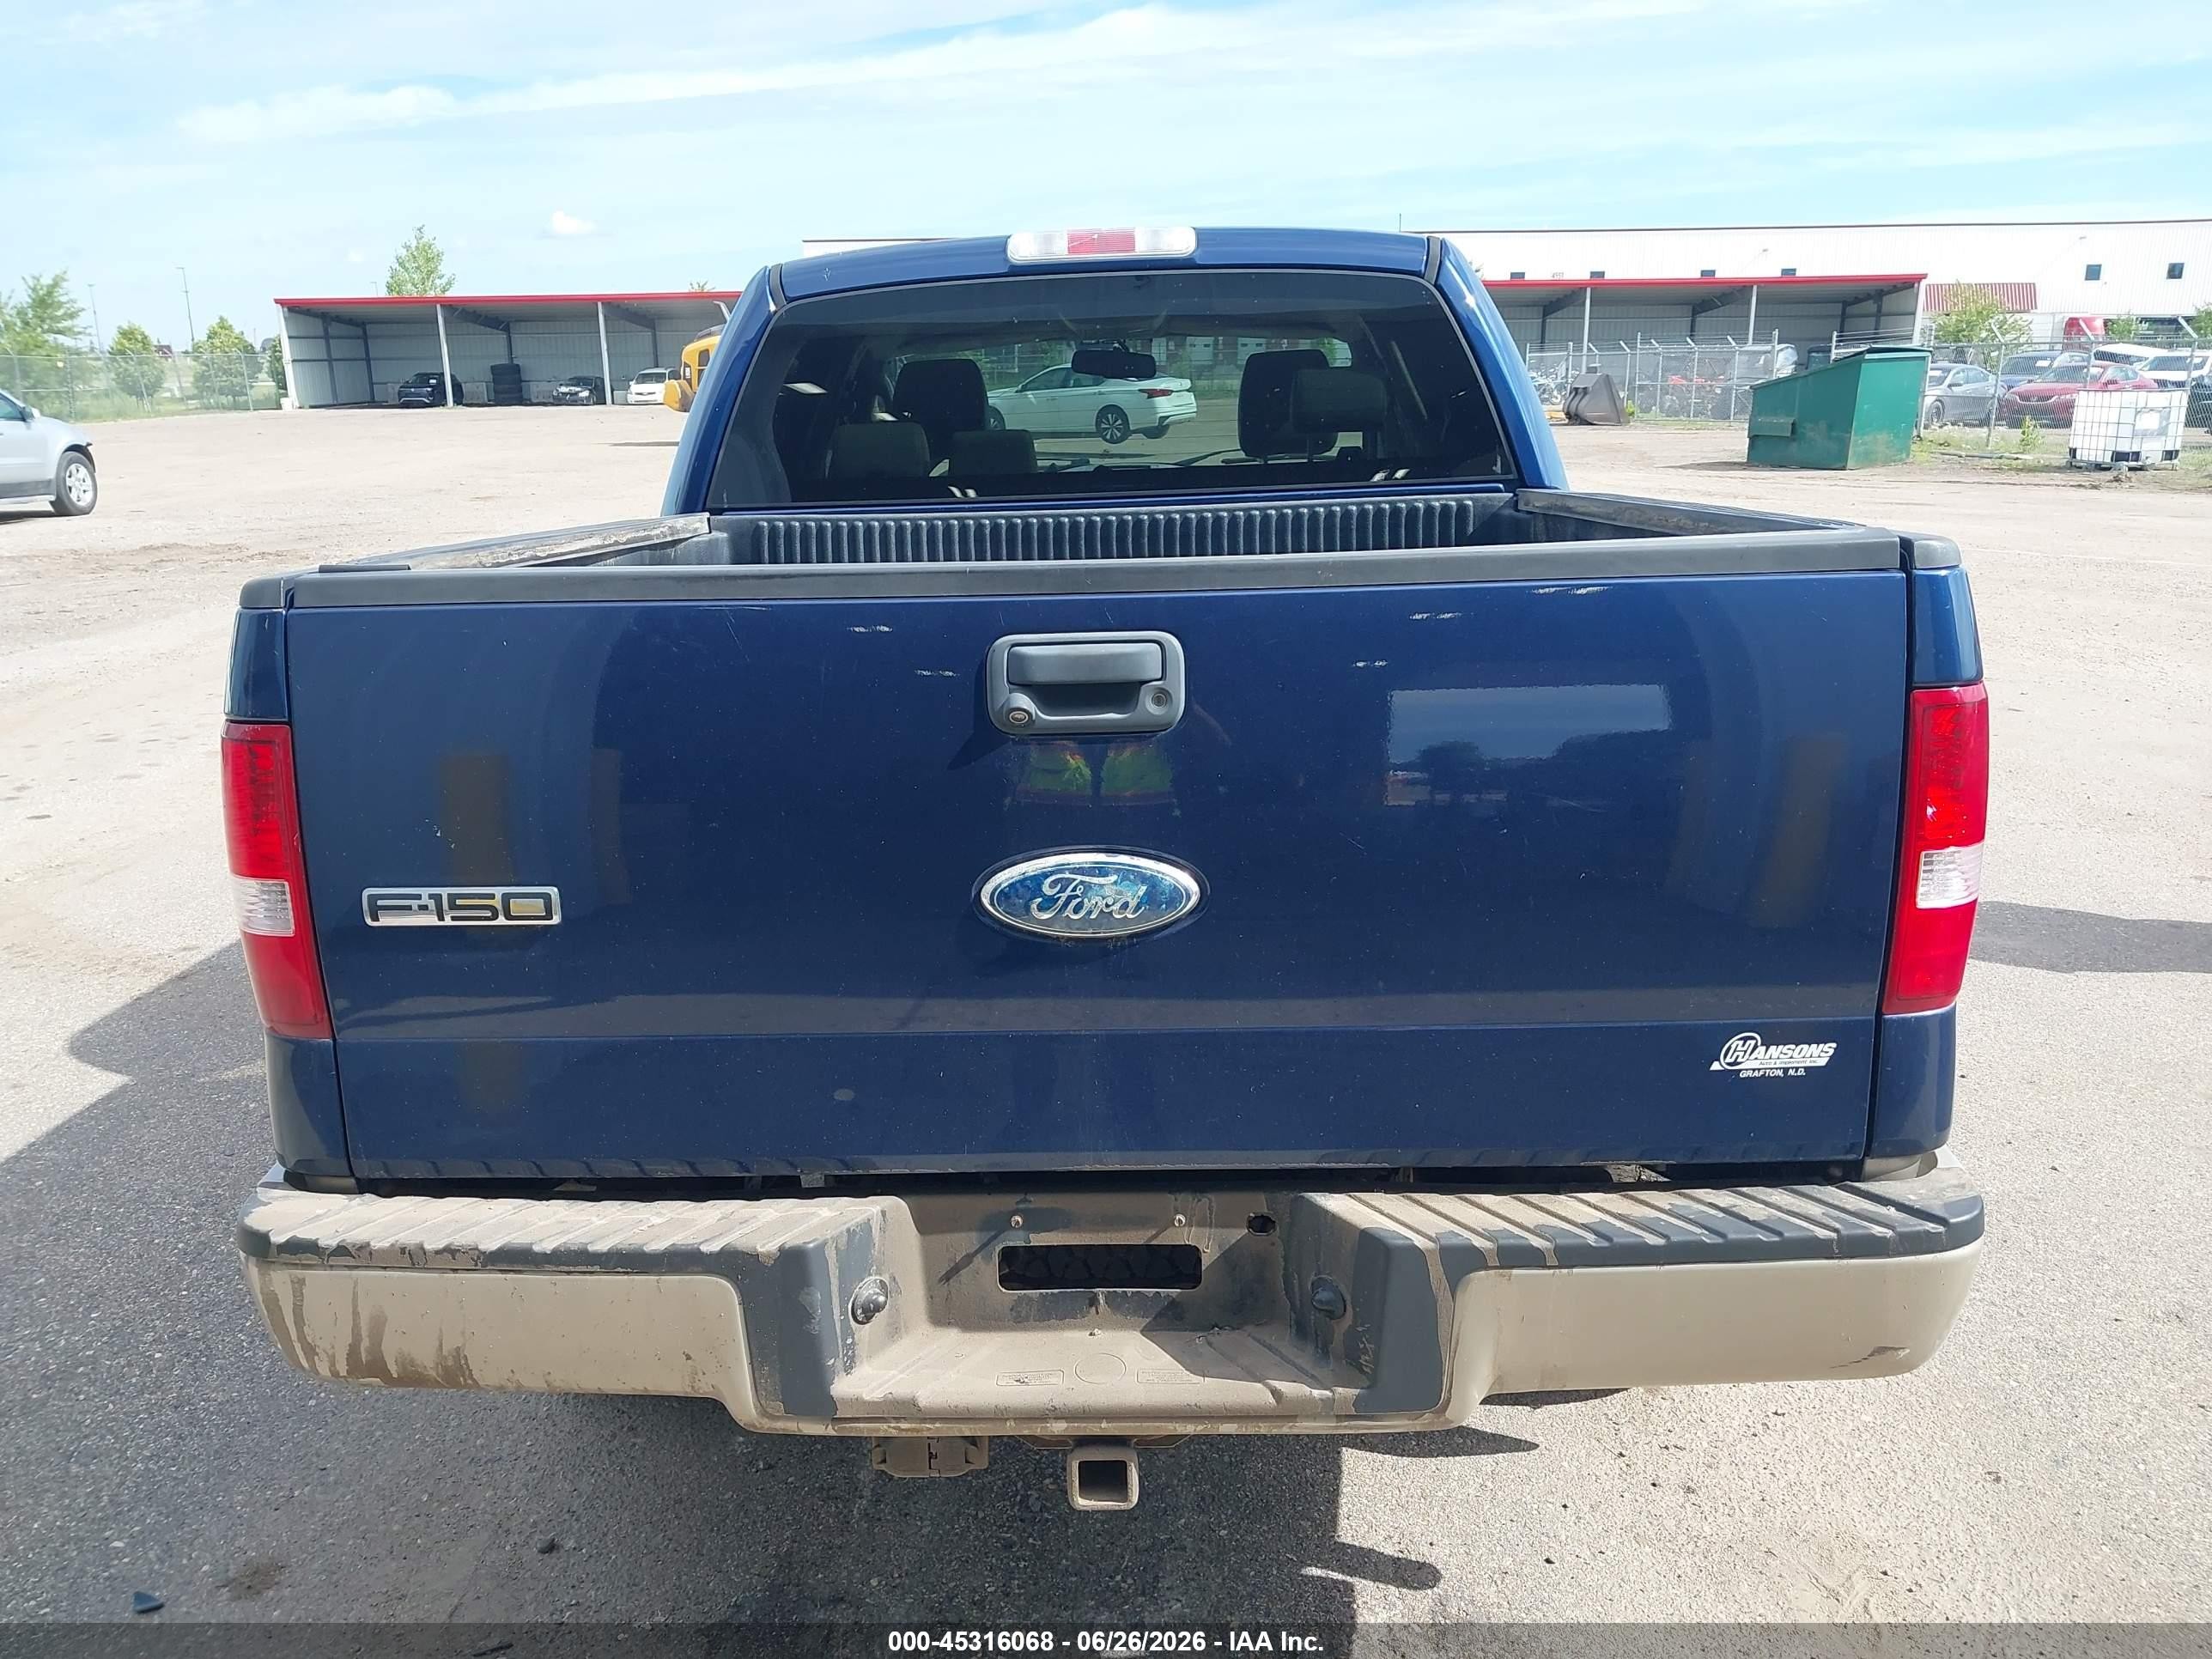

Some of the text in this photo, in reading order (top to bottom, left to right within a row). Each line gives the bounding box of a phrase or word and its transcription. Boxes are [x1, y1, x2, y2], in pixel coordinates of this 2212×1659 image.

[366, 892, 555, 922] F-150
[1030, 873, 1148, 920] Ford
[1724, 1040, 1838, 1064] HANSONS
[1739, 1067, 1806, 1079] GRAFTON, N.D.
